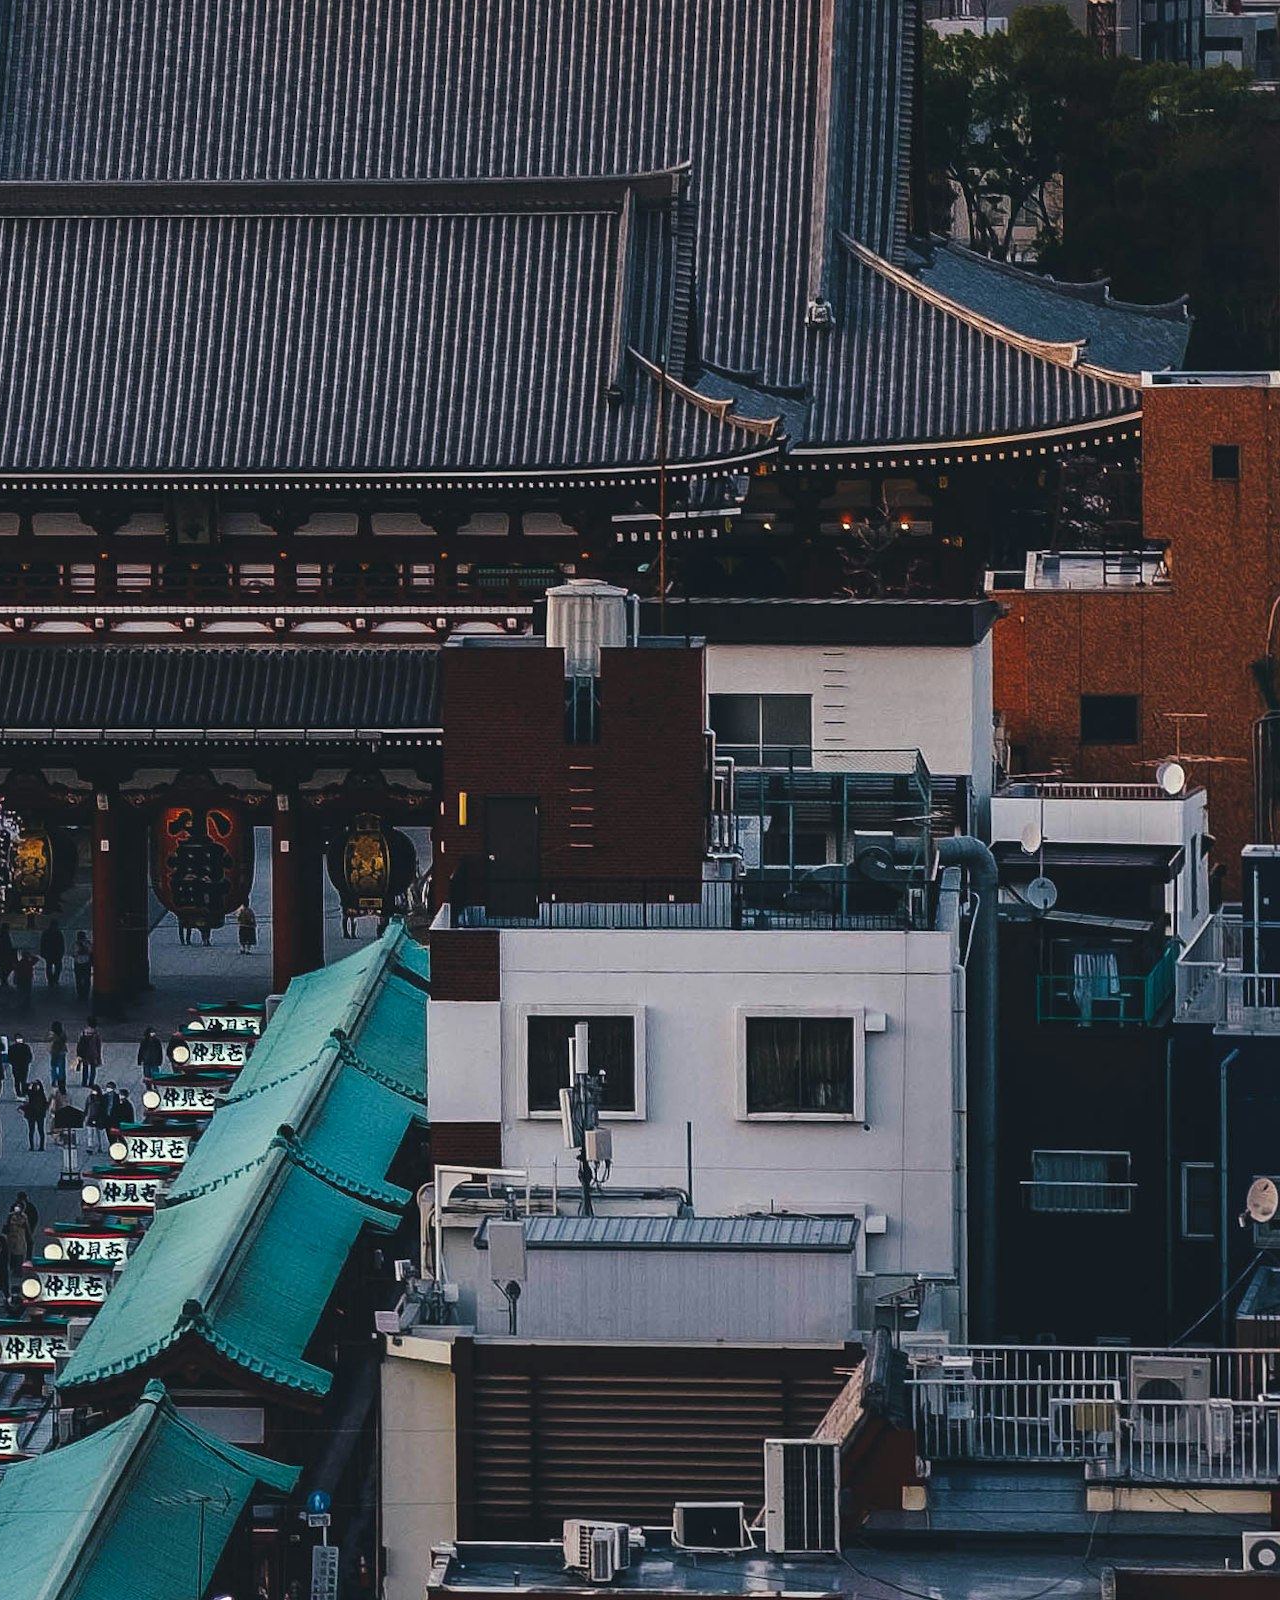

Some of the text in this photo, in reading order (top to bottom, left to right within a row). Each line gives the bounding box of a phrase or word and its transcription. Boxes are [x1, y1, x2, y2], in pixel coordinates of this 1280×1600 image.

[192, 1041, 243, 1063] 仲見世
[131, 1138, 185, 1160] 仲見世
[45, 1274, 102, 1297] 仲見世
